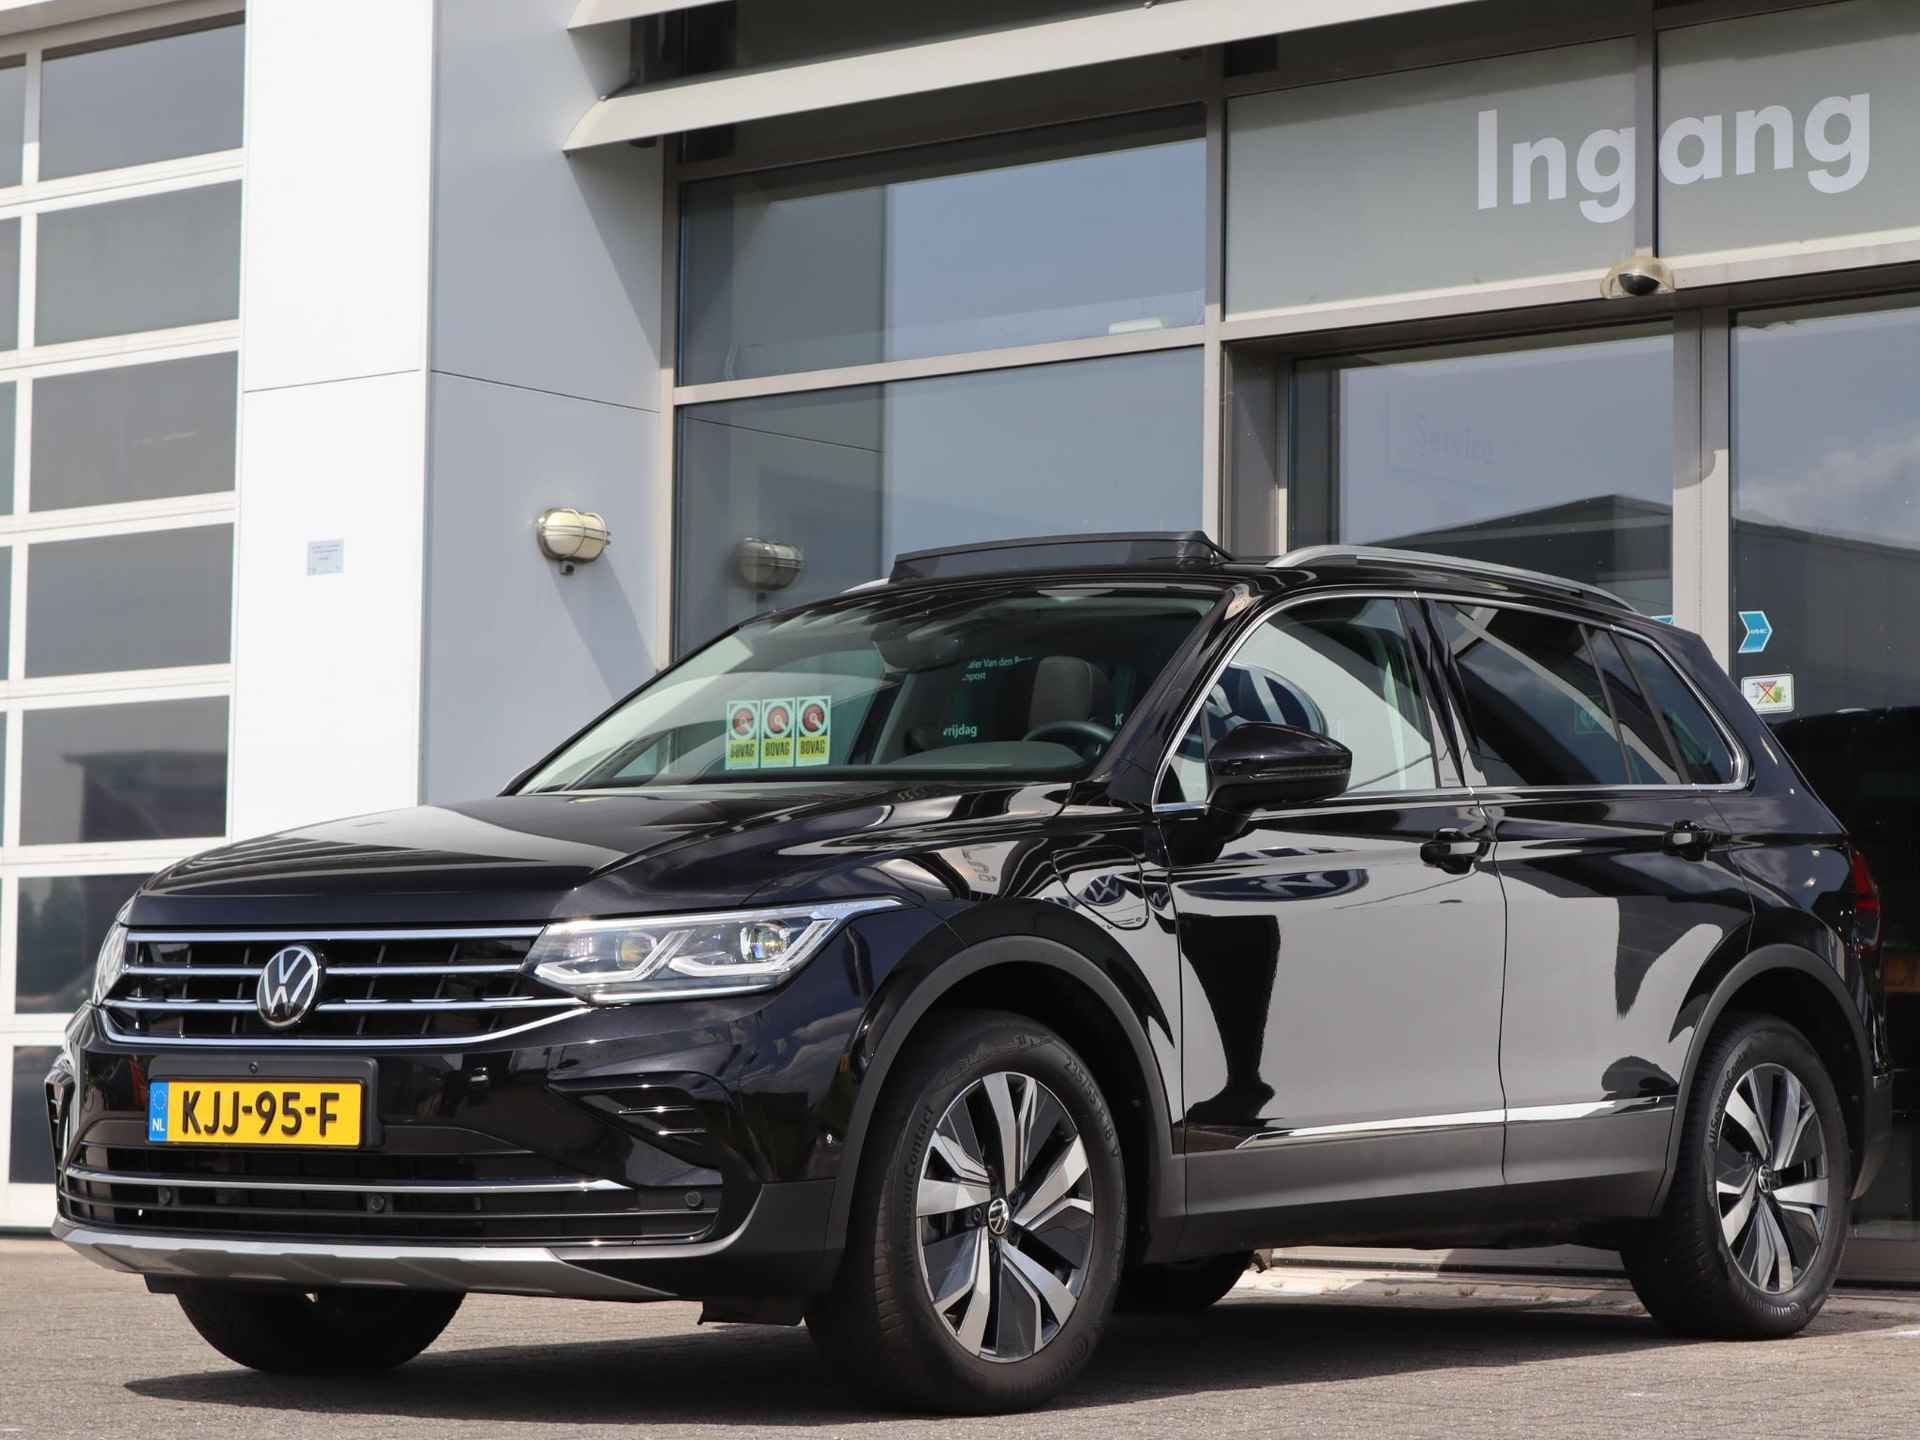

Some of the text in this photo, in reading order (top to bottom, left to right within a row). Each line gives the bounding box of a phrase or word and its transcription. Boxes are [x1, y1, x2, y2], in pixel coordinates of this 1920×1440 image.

[1478, 93, 1870, 223] Ingang
[943, 723, 977, 738] vrijdag
[801, 739, 825, 755] BOVAG
[181, 1090, 340, 1138] KJJ-95-F
[152, 1119, 166, 1133] NL
